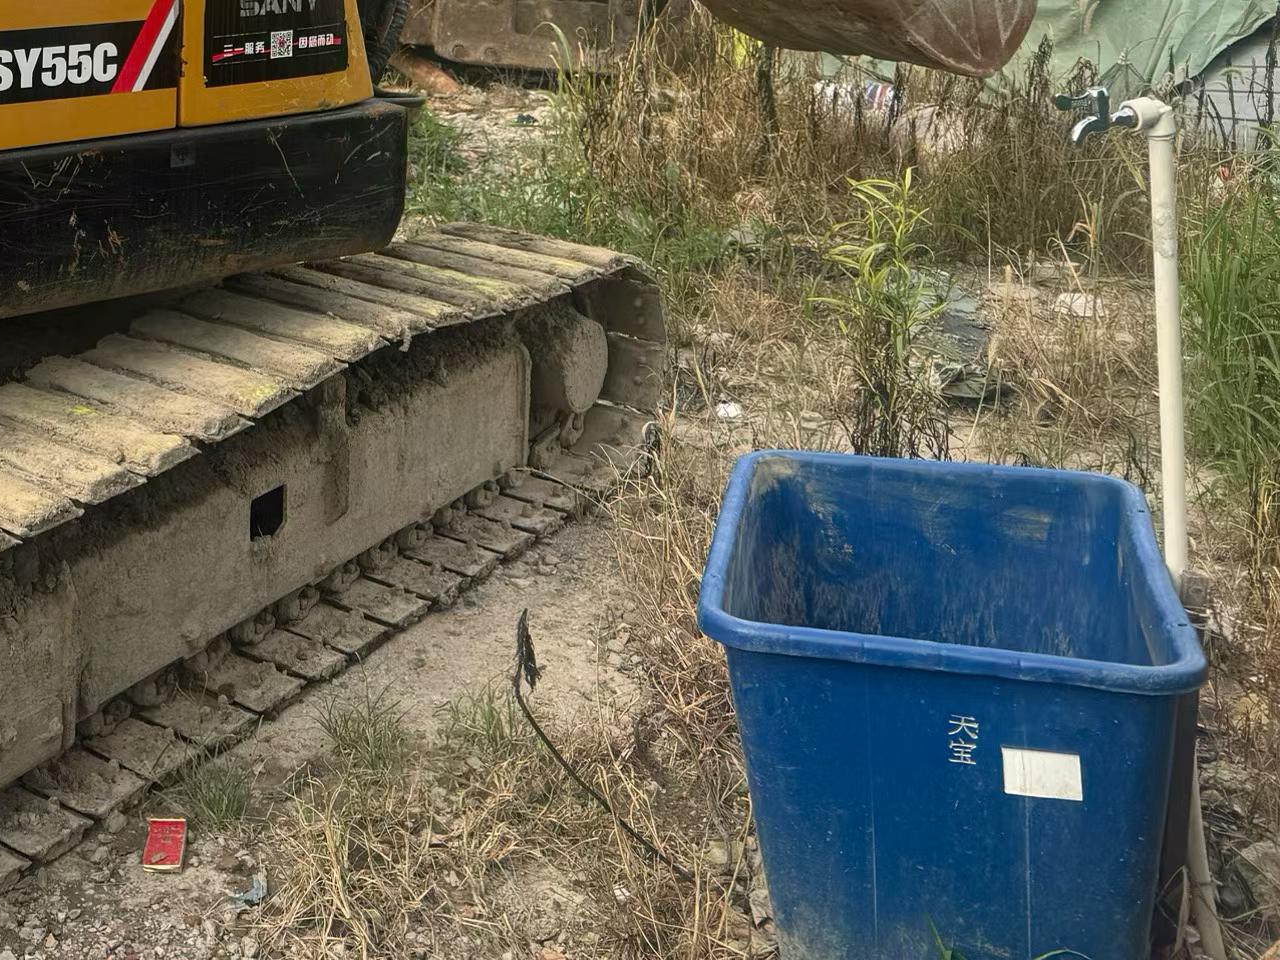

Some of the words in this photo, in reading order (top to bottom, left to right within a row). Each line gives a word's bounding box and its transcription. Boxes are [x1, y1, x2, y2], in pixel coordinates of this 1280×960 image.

[223, 41, 265, 58] 三一服务
[948, 714, 979, 765] 天宝
